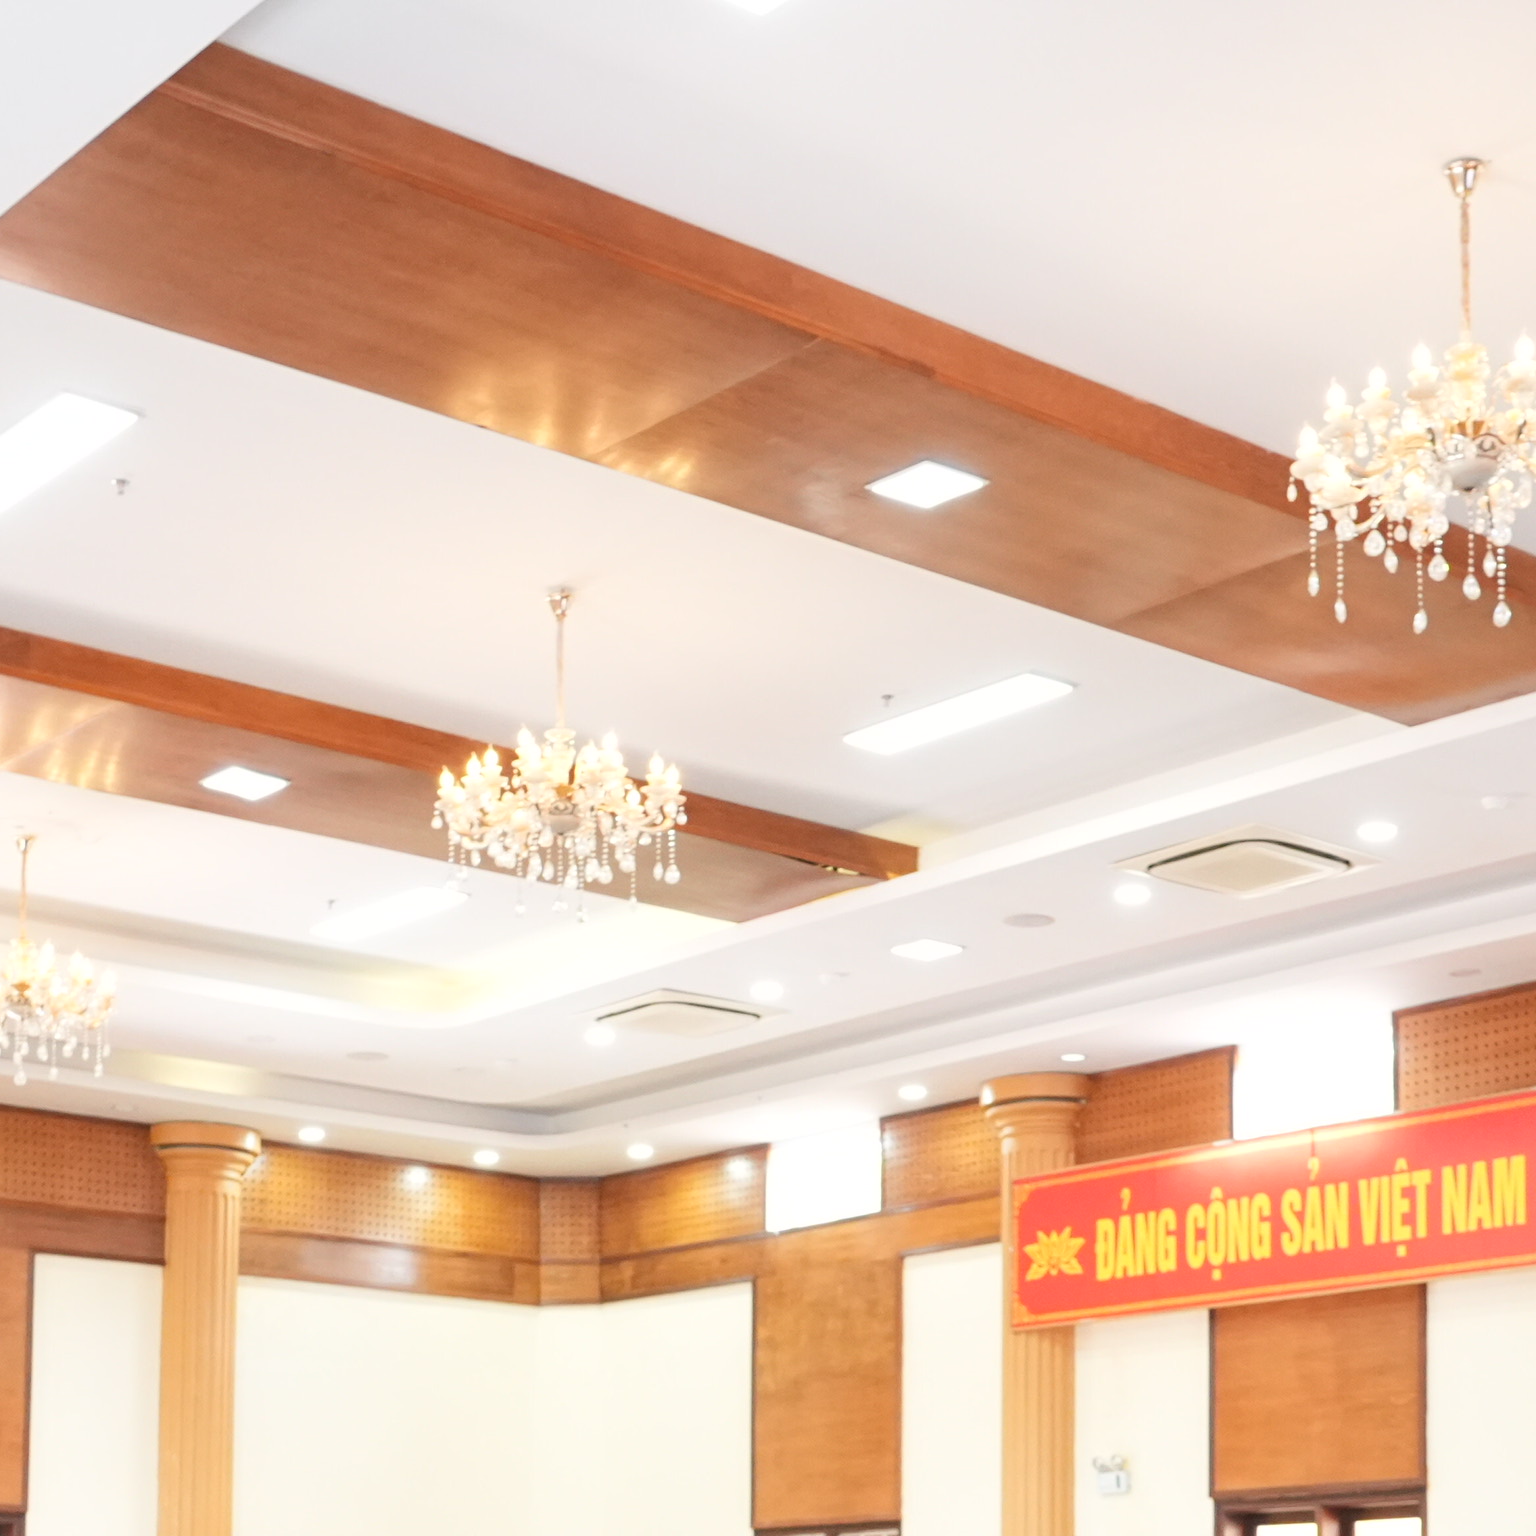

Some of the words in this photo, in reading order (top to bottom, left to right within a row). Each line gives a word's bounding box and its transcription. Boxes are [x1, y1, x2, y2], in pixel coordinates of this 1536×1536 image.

[1094, 1187, 1177, 1281] ĐẢNG
[1185, 1191, 1272, 1281] CỘNG
[1280, 1157, 1349, 1255] SẢN
[1358, 1157, 1432, 1257] VIỆT
[1442, 1155, 1527, 1236] NAM
